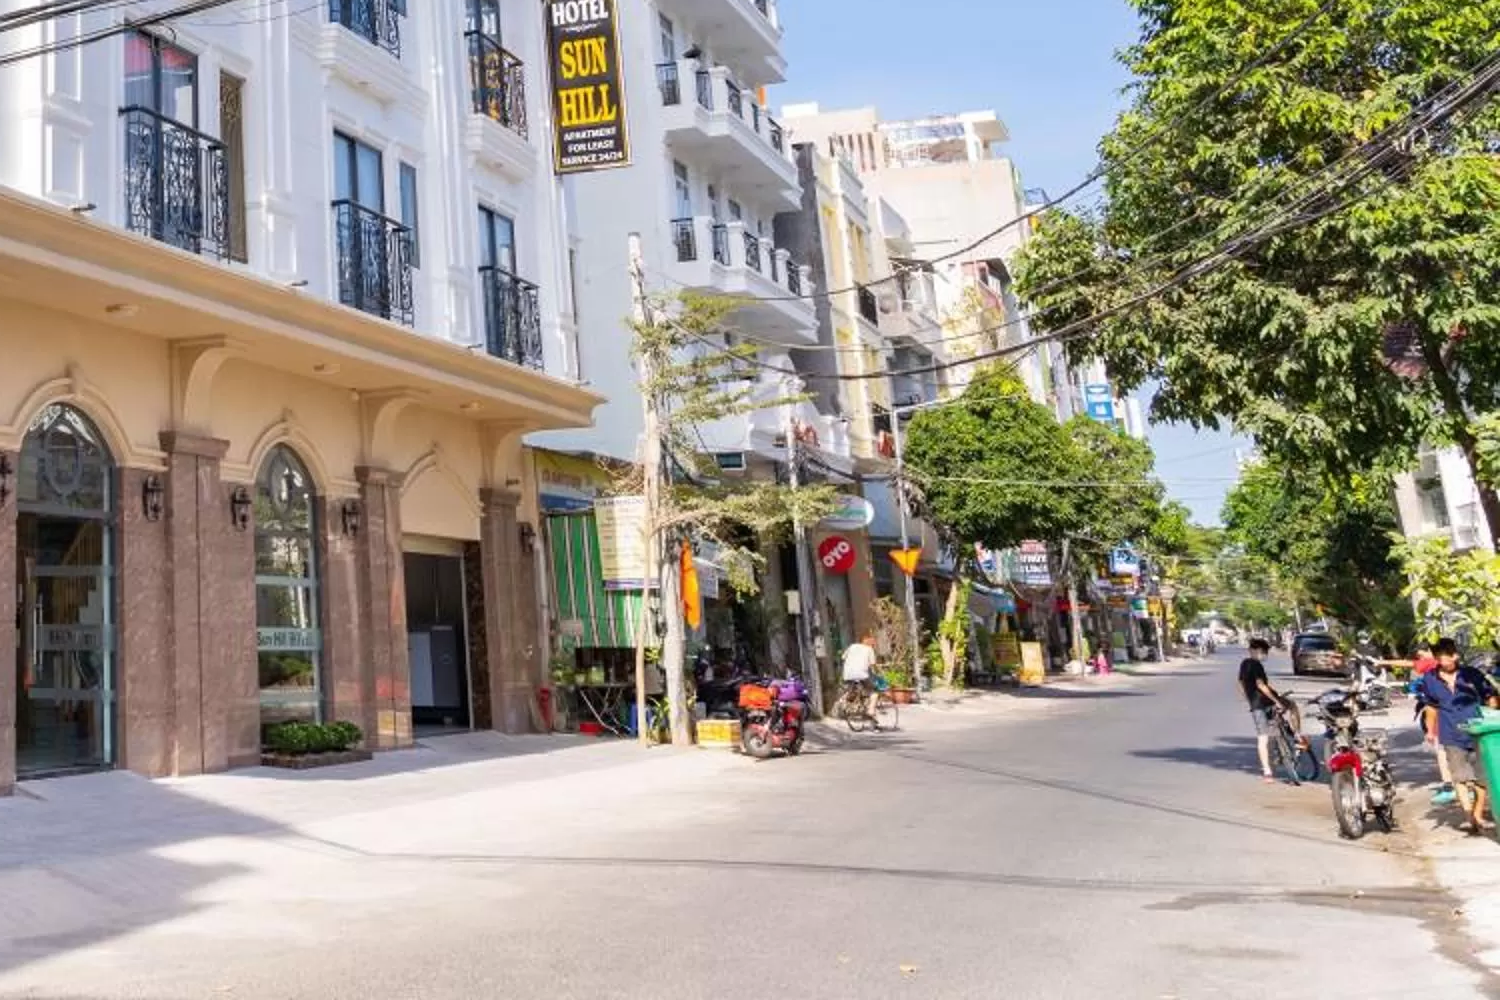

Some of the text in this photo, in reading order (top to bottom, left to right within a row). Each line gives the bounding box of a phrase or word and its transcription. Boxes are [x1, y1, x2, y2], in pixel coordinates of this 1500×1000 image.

[560, 37, 607, 80] SUN
[559, 83, 617, 128] HILL
[564, 126, 617, 141] APARTMENT
[568, 140, 614, 153] FOR LEASE
[823, 541, 851, 568] OYO
